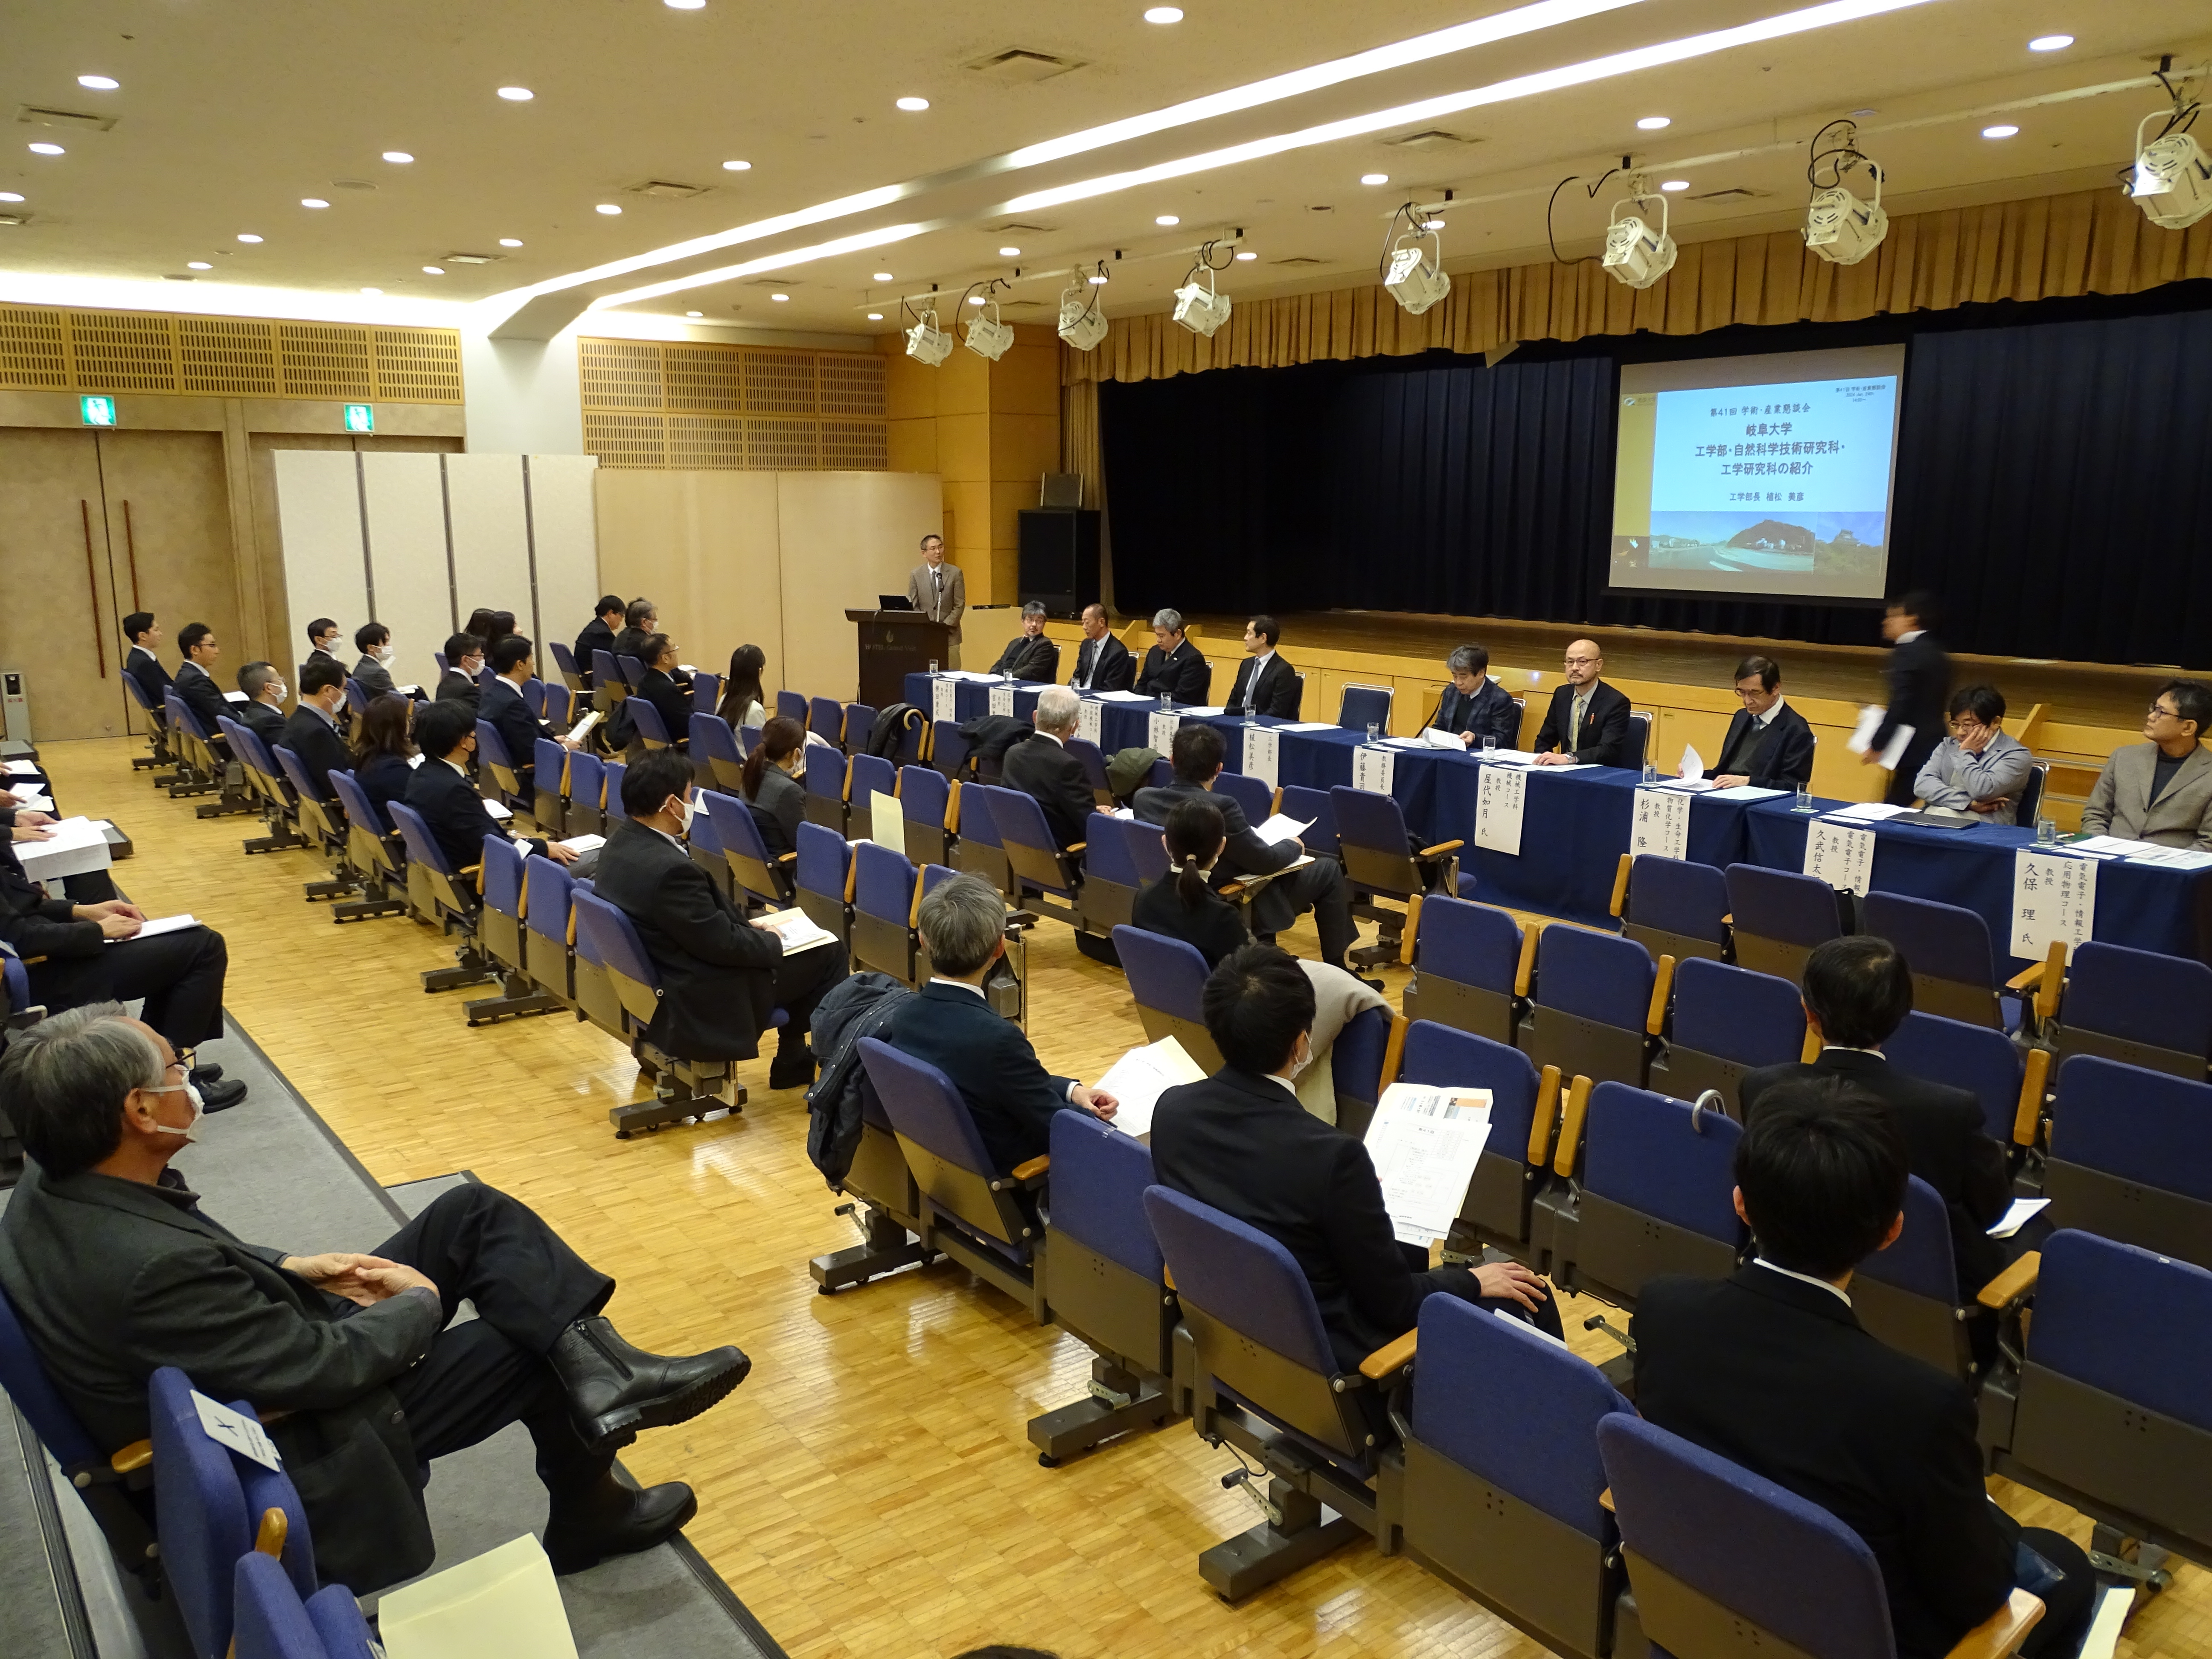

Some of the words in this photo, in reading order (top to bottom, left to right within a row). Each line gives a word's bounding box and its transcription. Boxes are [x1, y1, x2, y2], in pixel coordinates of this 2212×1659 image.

[1710, 407, 1738, 417] 第41回
[1746, 422, 1792, 437] 岐阜大学
[1721, 461, 1813, 476] 工学研究科の紹介
[1729, 492, 1761, 501] 工学部長
[1766, 492, 1782, 501] 植松
[1788, 492, 1805, 501] 美彦
[1495, 778, 1501, 792] 教授
[1513, 774, 1521, 810] 機械工学科
[1482, 774, 1491, 819] 屋代如月
[1639, 798, 1649, 823] 杉浦
[1654, 803, 1661, 818] 教授
[1481, 828, 1488, 837] 氏
[1664, 797, 1674, 851] 物質化学コース
[1673, 798, 1684, 859] 化学・生命工学科
[1638, 837, 1647, 847] 隆
[1831, 836, 1839, 853] 教授
[1841, 831, 1854, 889] 電気電子コース
[2023, 863, 2039, 891] 久保
[2044, 867, 2054, 886] 教授
[2060, 861, 2072, 927] 応用物理コース
[2021, 909, 2035, 920] 理
[2073, 862, 2088, 950] 電気電子・情報工学
[2022, 933, 2033, 945] 氏
